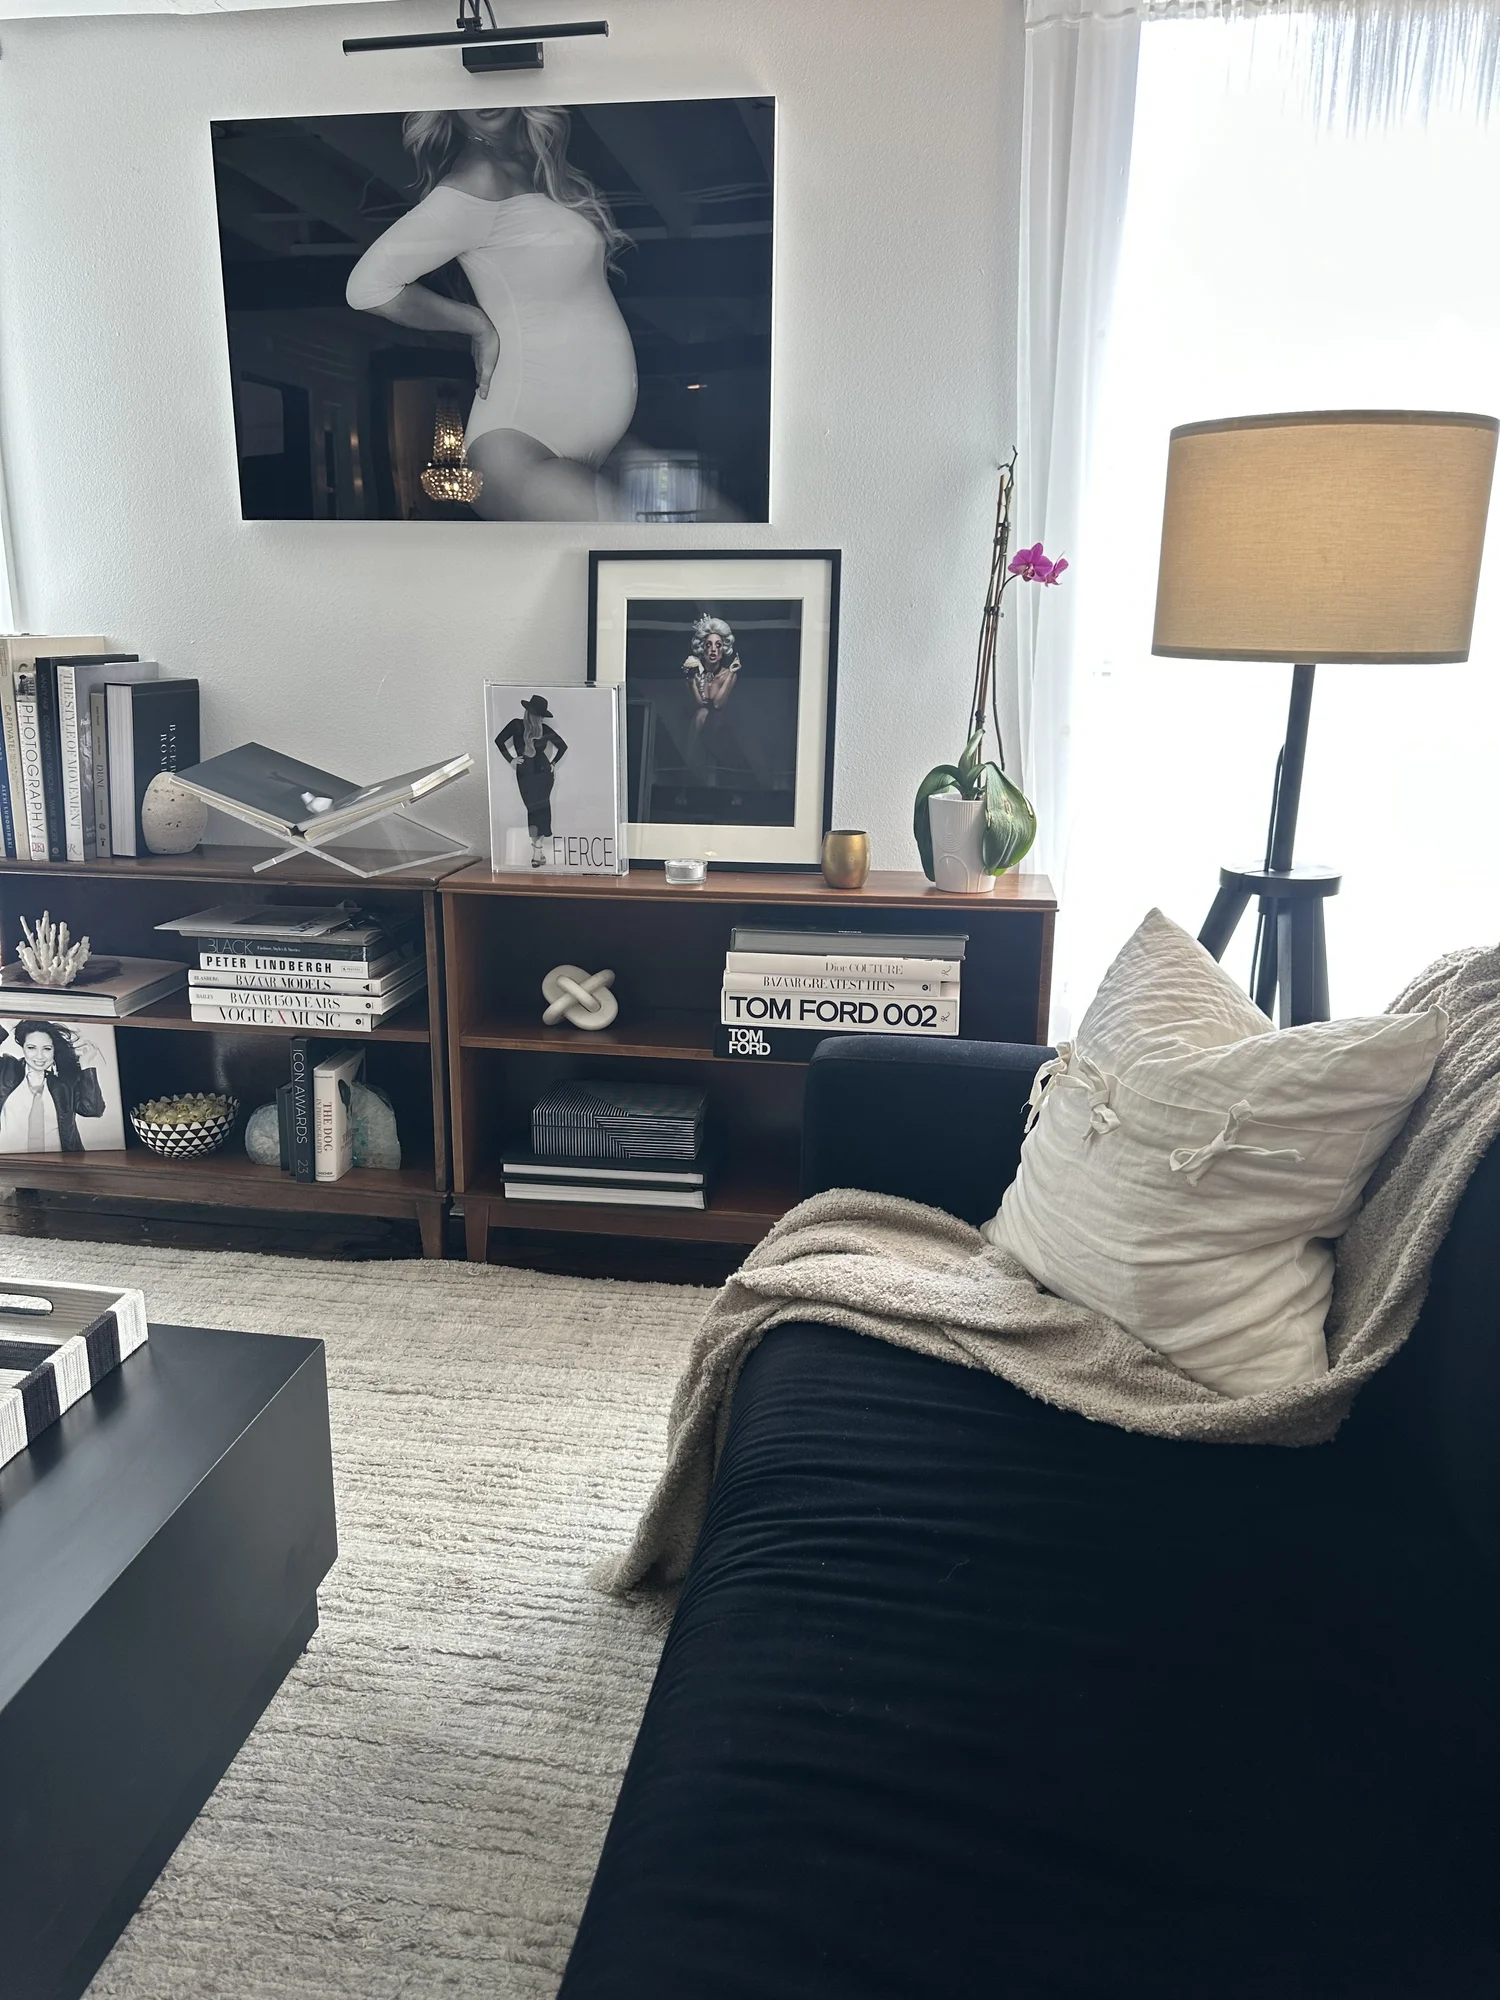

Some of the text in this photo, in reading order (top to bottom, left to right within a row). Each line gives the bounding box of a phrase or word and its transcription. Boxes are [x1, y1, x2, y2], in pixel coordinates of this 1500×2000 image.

[63, 673, 81, 829] THE STYLE OF MOVEMENT
[22, 704, 44, 832] PHOTOGRAPHY
[96, 764, 104, 788] DUNE
[4, 806, 13, 849] LUBOMIRSKI
[553, 837, 614, 867] FIERCE
[207, 938, 254, 955] BLACK
[206, 956, 332, 973] PETER LINDBERGH
[825, 962, 904, 975] Dior COUTURE
[236, 975, 332, 991] BAZAAR MODELS
[763, 976, 895, 992] BAZAAR GREATEST HITS
[230, 992, 341, 1009] BAZAAR 150 YEARS
[729, 996, 937, 1027] TOM FORD 002
[219, 1006, 341, 1028] VOGUE X MUSIC
[728, 1029, 763, 1042] TOM
[729, 1041, 771, 1055] FORD
[293, 1049, 309, 1174] ICON AWARDS 23
[322, 1101, 333, 1152] THE DOG
